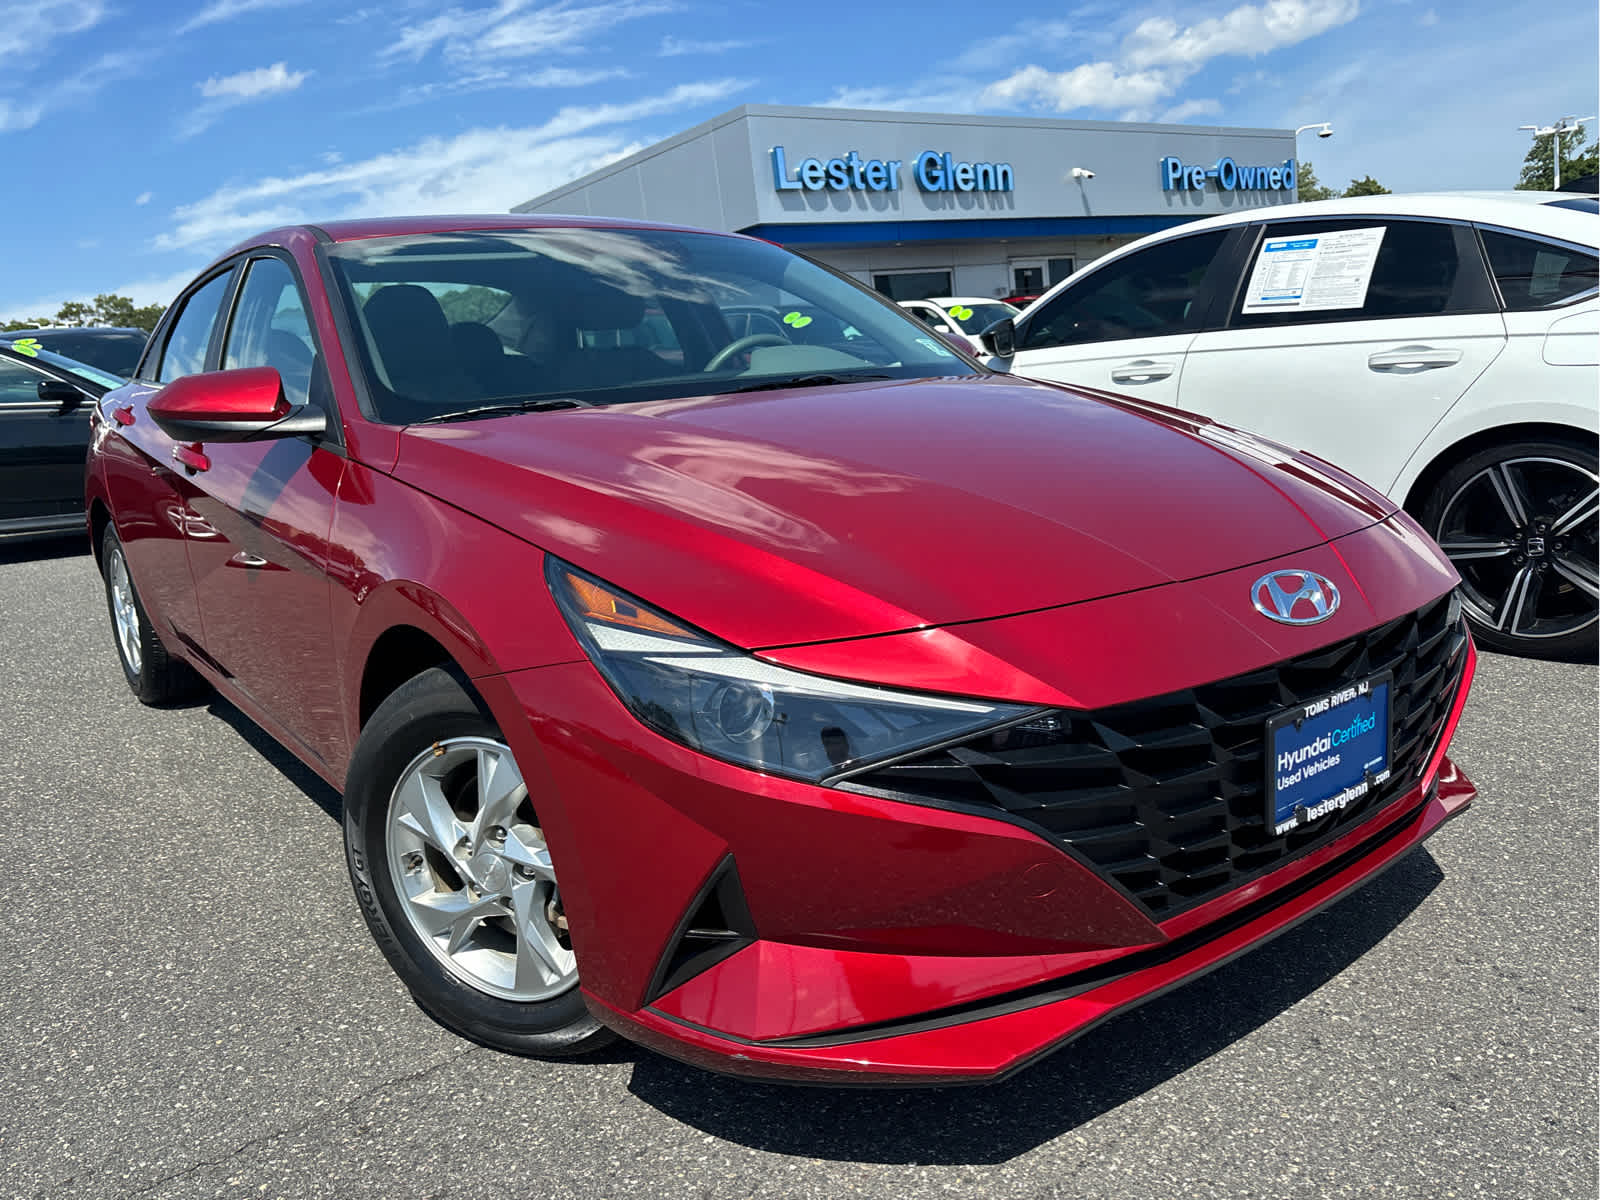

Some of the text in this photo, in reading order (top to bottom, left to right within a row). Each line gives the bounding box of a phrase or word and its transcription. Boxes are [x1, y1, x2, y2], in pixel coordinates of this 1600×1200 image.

[769, 146, 1015, 192] Lester Glenn
[1161, 156, 1296, 192] Pre-Owned
[1304, 681, 1369, 718] TOMS RIVER, NJ
[1277, 711, 1376, 772] Hyundai Certified
[1277, 772, 1301, 791] Used
[1303, 753, 1341, 779] Vehicles
[1304, 781, 1368, 822] lesterglenn
